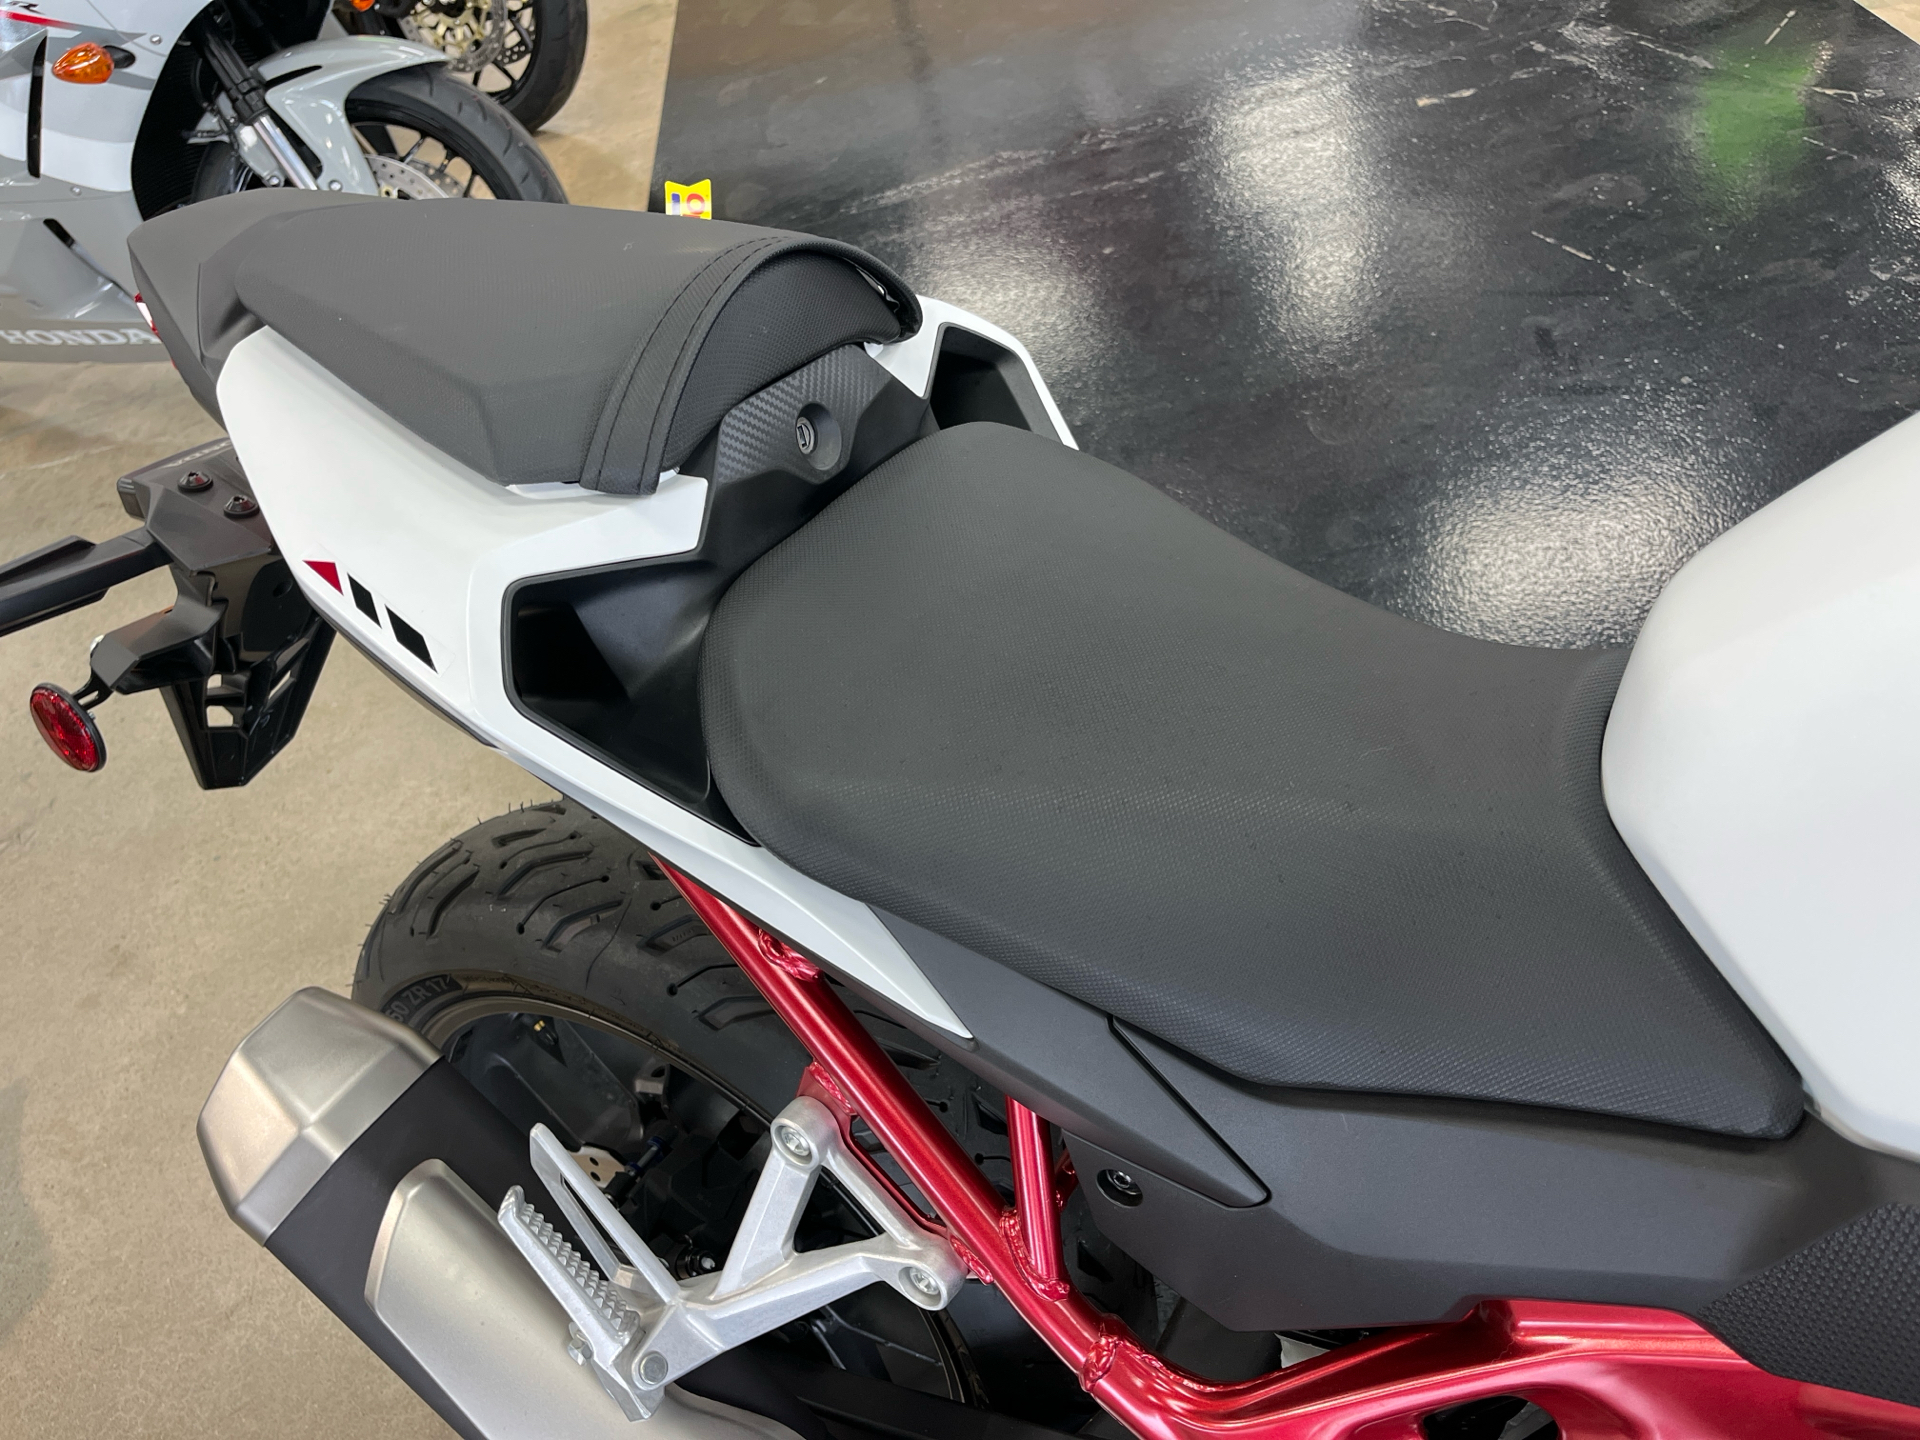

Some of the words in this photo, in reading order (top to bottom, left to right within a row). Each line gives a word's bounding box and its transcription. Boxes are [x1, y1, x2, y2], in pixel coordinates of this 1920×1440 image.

[0, 328, 163, 345] HONDA
[401, 985, 432, 1005] ZR
[425, 977, 448, 992] 17
